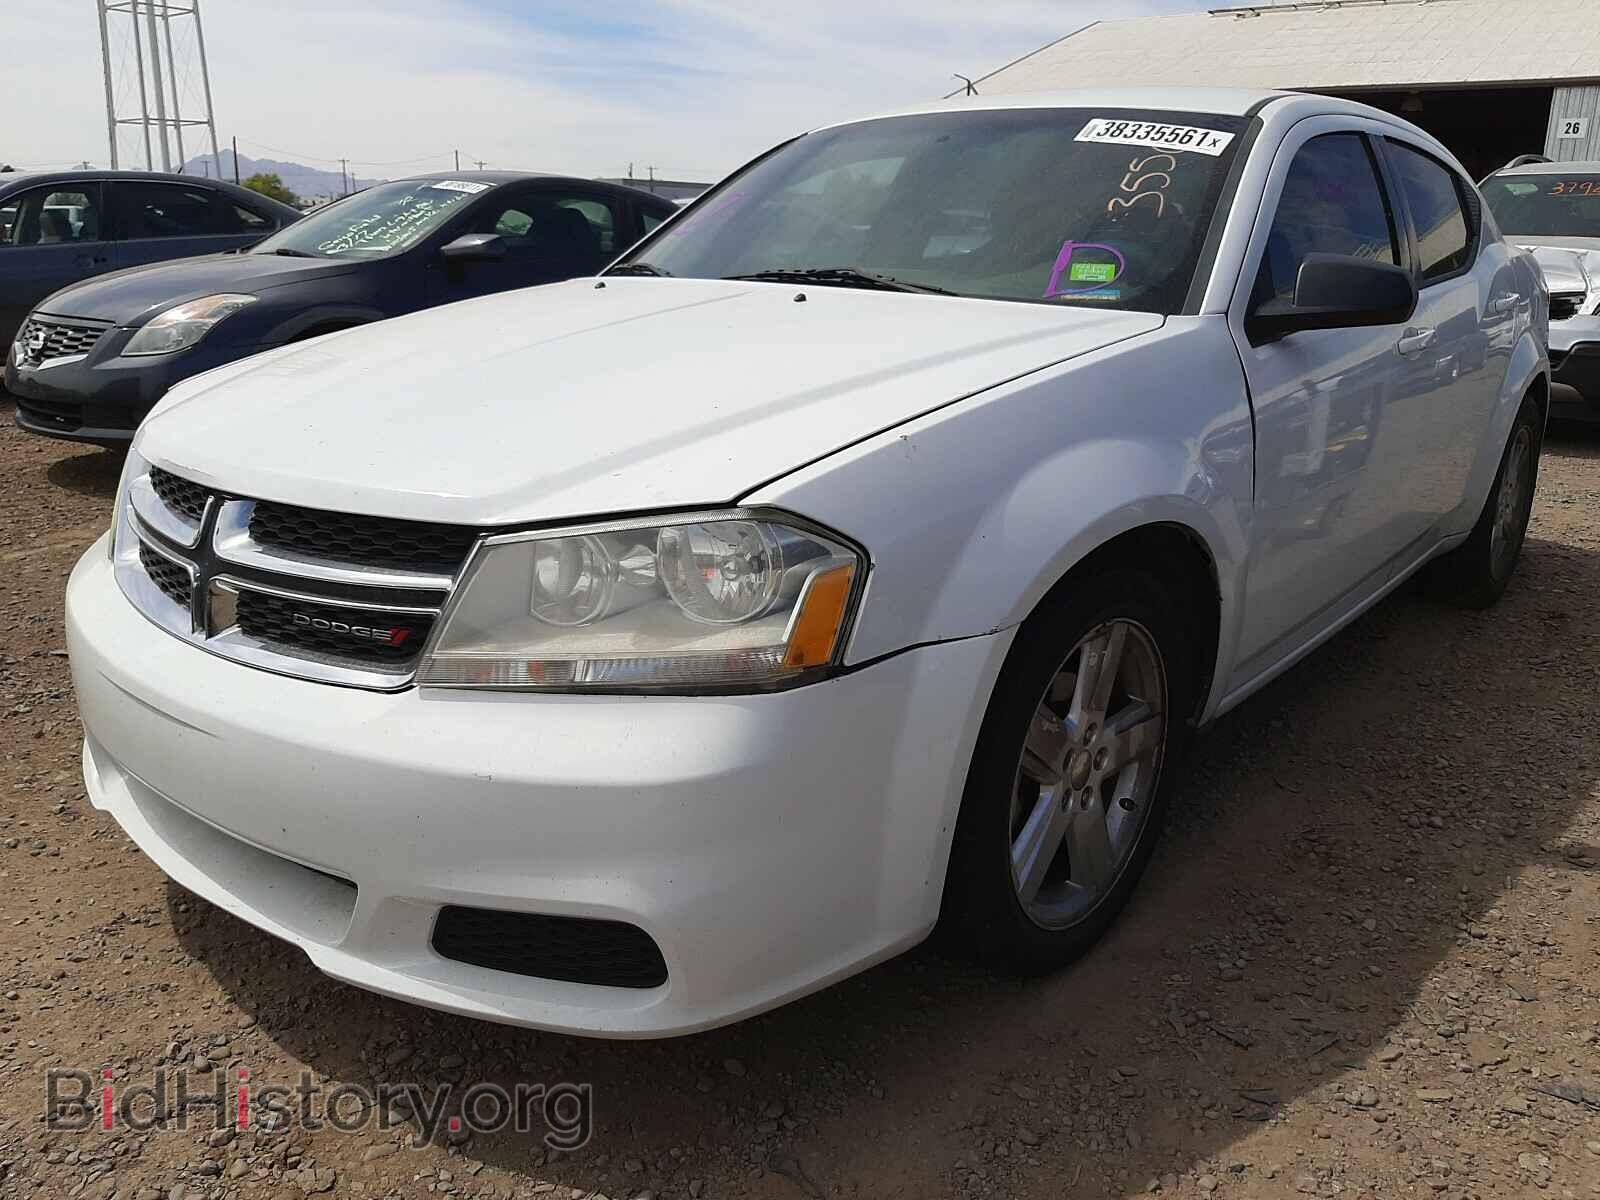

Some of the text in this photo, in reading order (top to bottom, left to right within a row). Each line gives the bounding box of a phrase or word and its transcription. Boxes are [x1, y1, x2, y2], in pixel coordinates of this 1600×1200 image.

[1096, 121, 1210, 147] 38335561
[1564, 121, 1581, 135] 26
[1107, 147, 1183, 218] 355
[292, 613, 393, 641] DODGE
